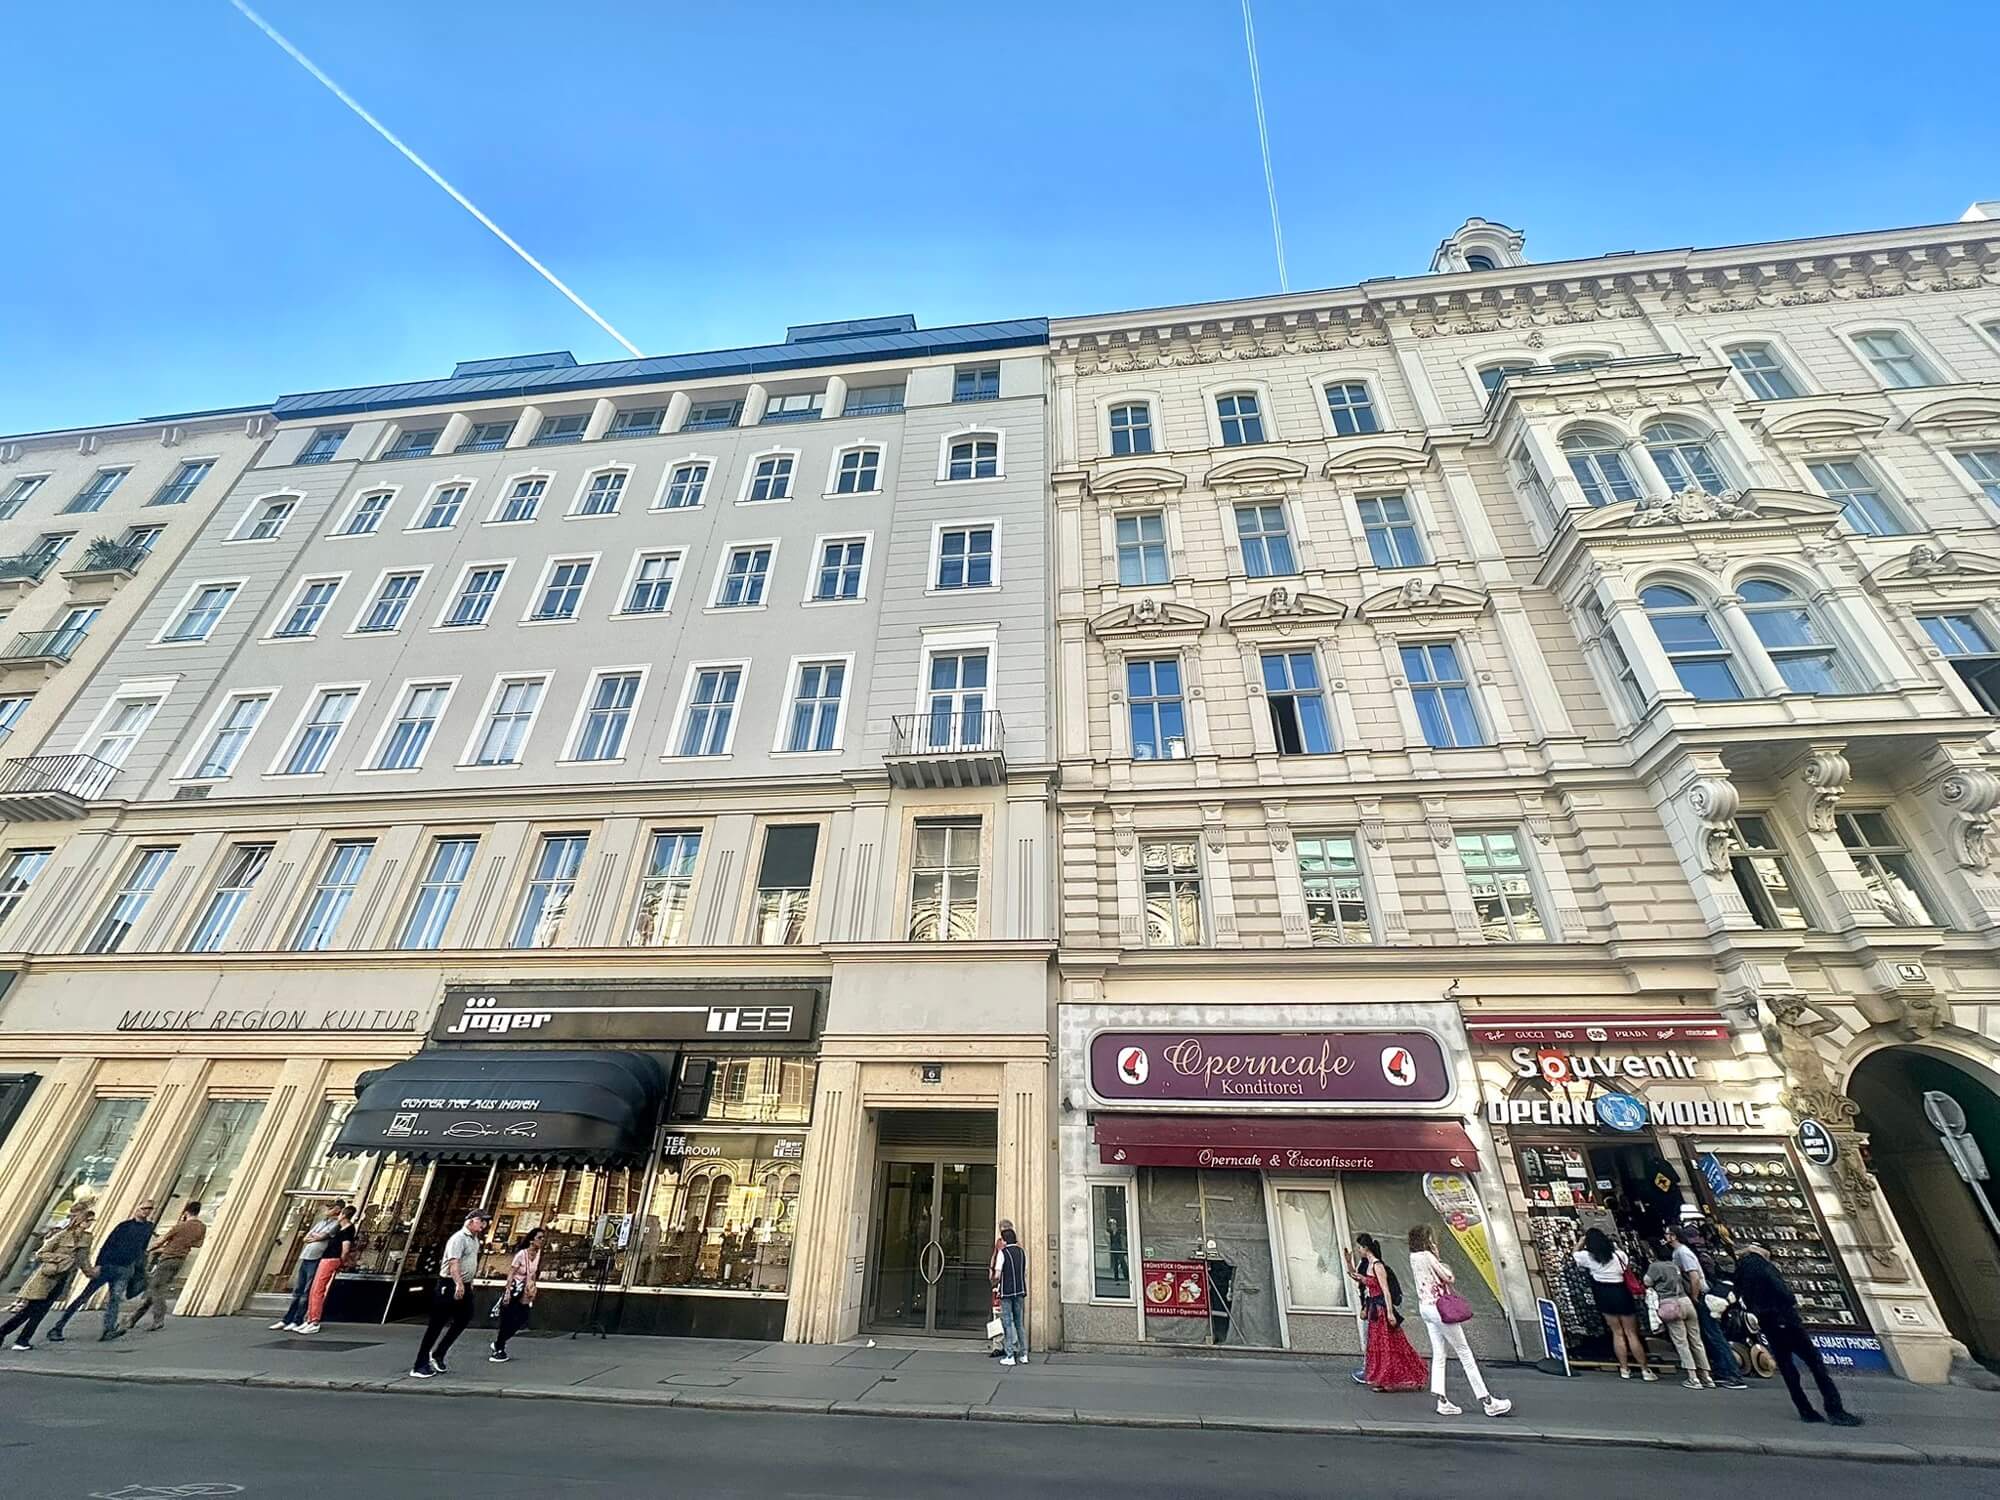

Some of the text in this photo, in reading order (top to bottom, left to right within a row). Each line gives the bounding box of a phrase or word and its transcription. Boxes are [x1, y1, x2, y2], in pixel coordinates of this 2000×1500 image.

[117, 1010, 419, 1031] MUSIK REGION KULTUR
[706, 1006, 793, 1032] TEE
[1515, 1031, 1545, 1039] GUCCI
[1554, 1031, 1575, 1039] D&G
[1615, 1030, 1648, 1038] PRADA
[1163, 1038, 1356, 1090] Operncafe
[1511, 1047, 1699, 1079] Souvenir
[928, 1070, 936, 1079] 6
[1222, 1079, 1304, 1095] Konditorei
[1487, 1099, 1765, 1126] OPERN MOBILE
[665, 1136, 687, 1146] TEE
[664, 1146, 721, 1156] TEAROOM
[1198, 1149, 1374, 1168] Operncafe & Eisconfisserie
[1819, 1336, 1846, 1349] SMART
[1846, 1338, 1880, 1350] PHONES
[1836, 1354, 1854, 1366] here
